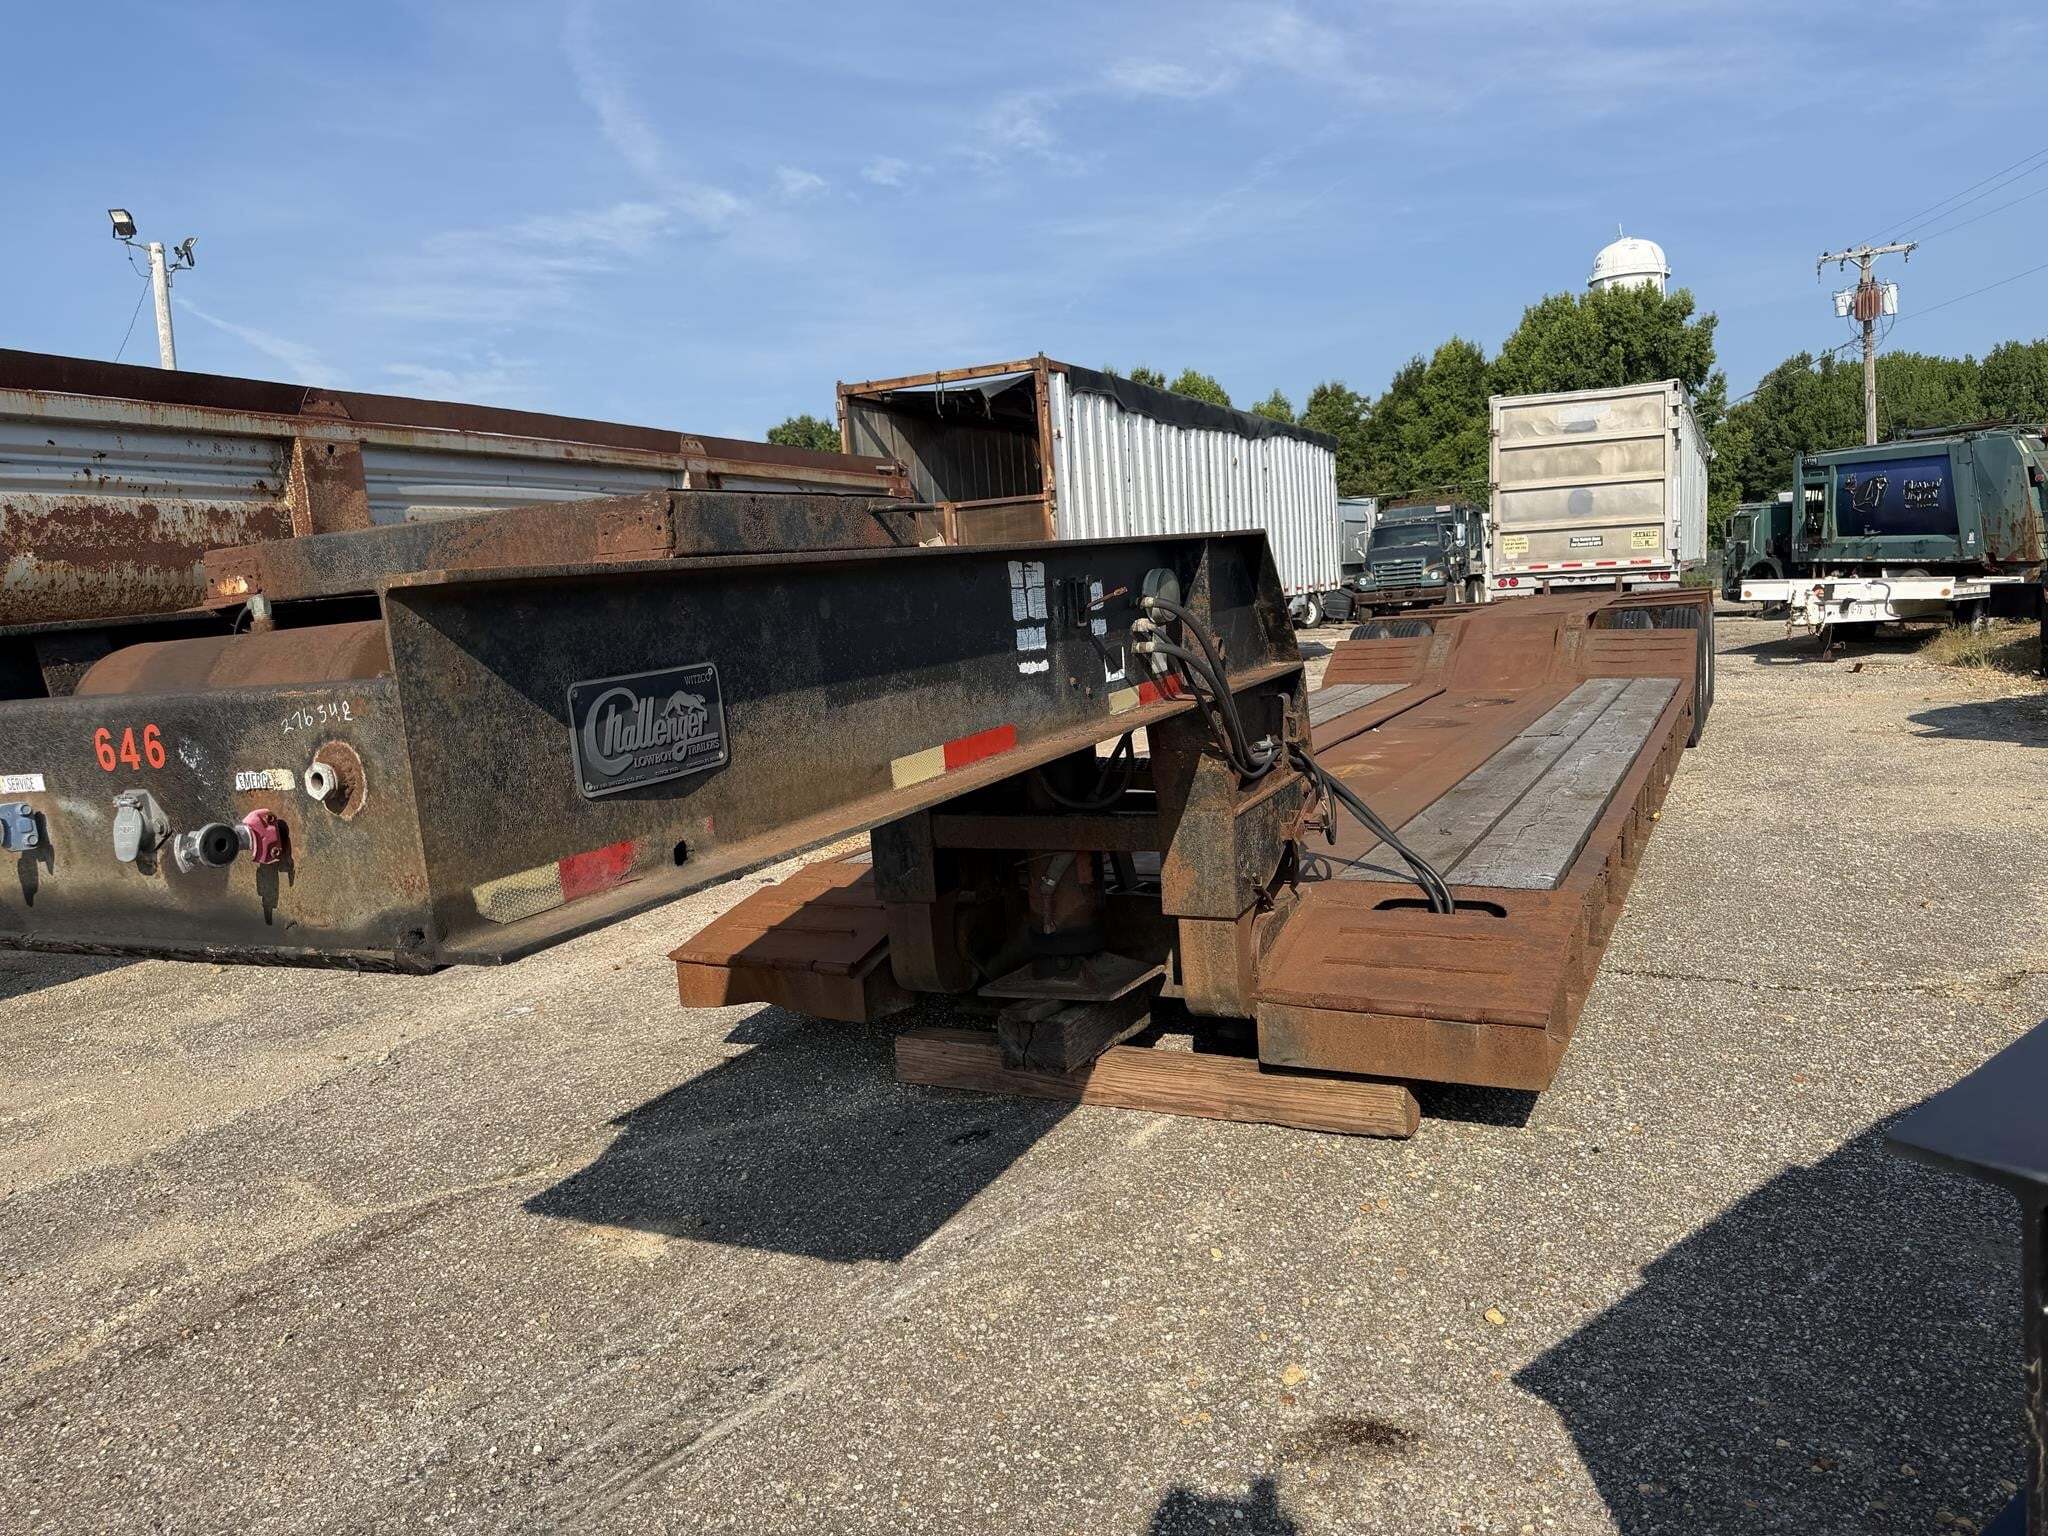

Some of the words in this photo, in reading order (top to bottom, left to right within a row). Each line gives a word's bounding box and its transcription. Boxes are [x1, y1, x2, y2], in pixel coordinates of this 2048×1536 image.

[94, 724, 166, 772] 646
[585, 687, 717, 775] Challenger
[634, 750, 673, 768] LOWBOY
[687, 738, 721, 756] TRAILERS
[6, 776, 36, 791] SERVICE
